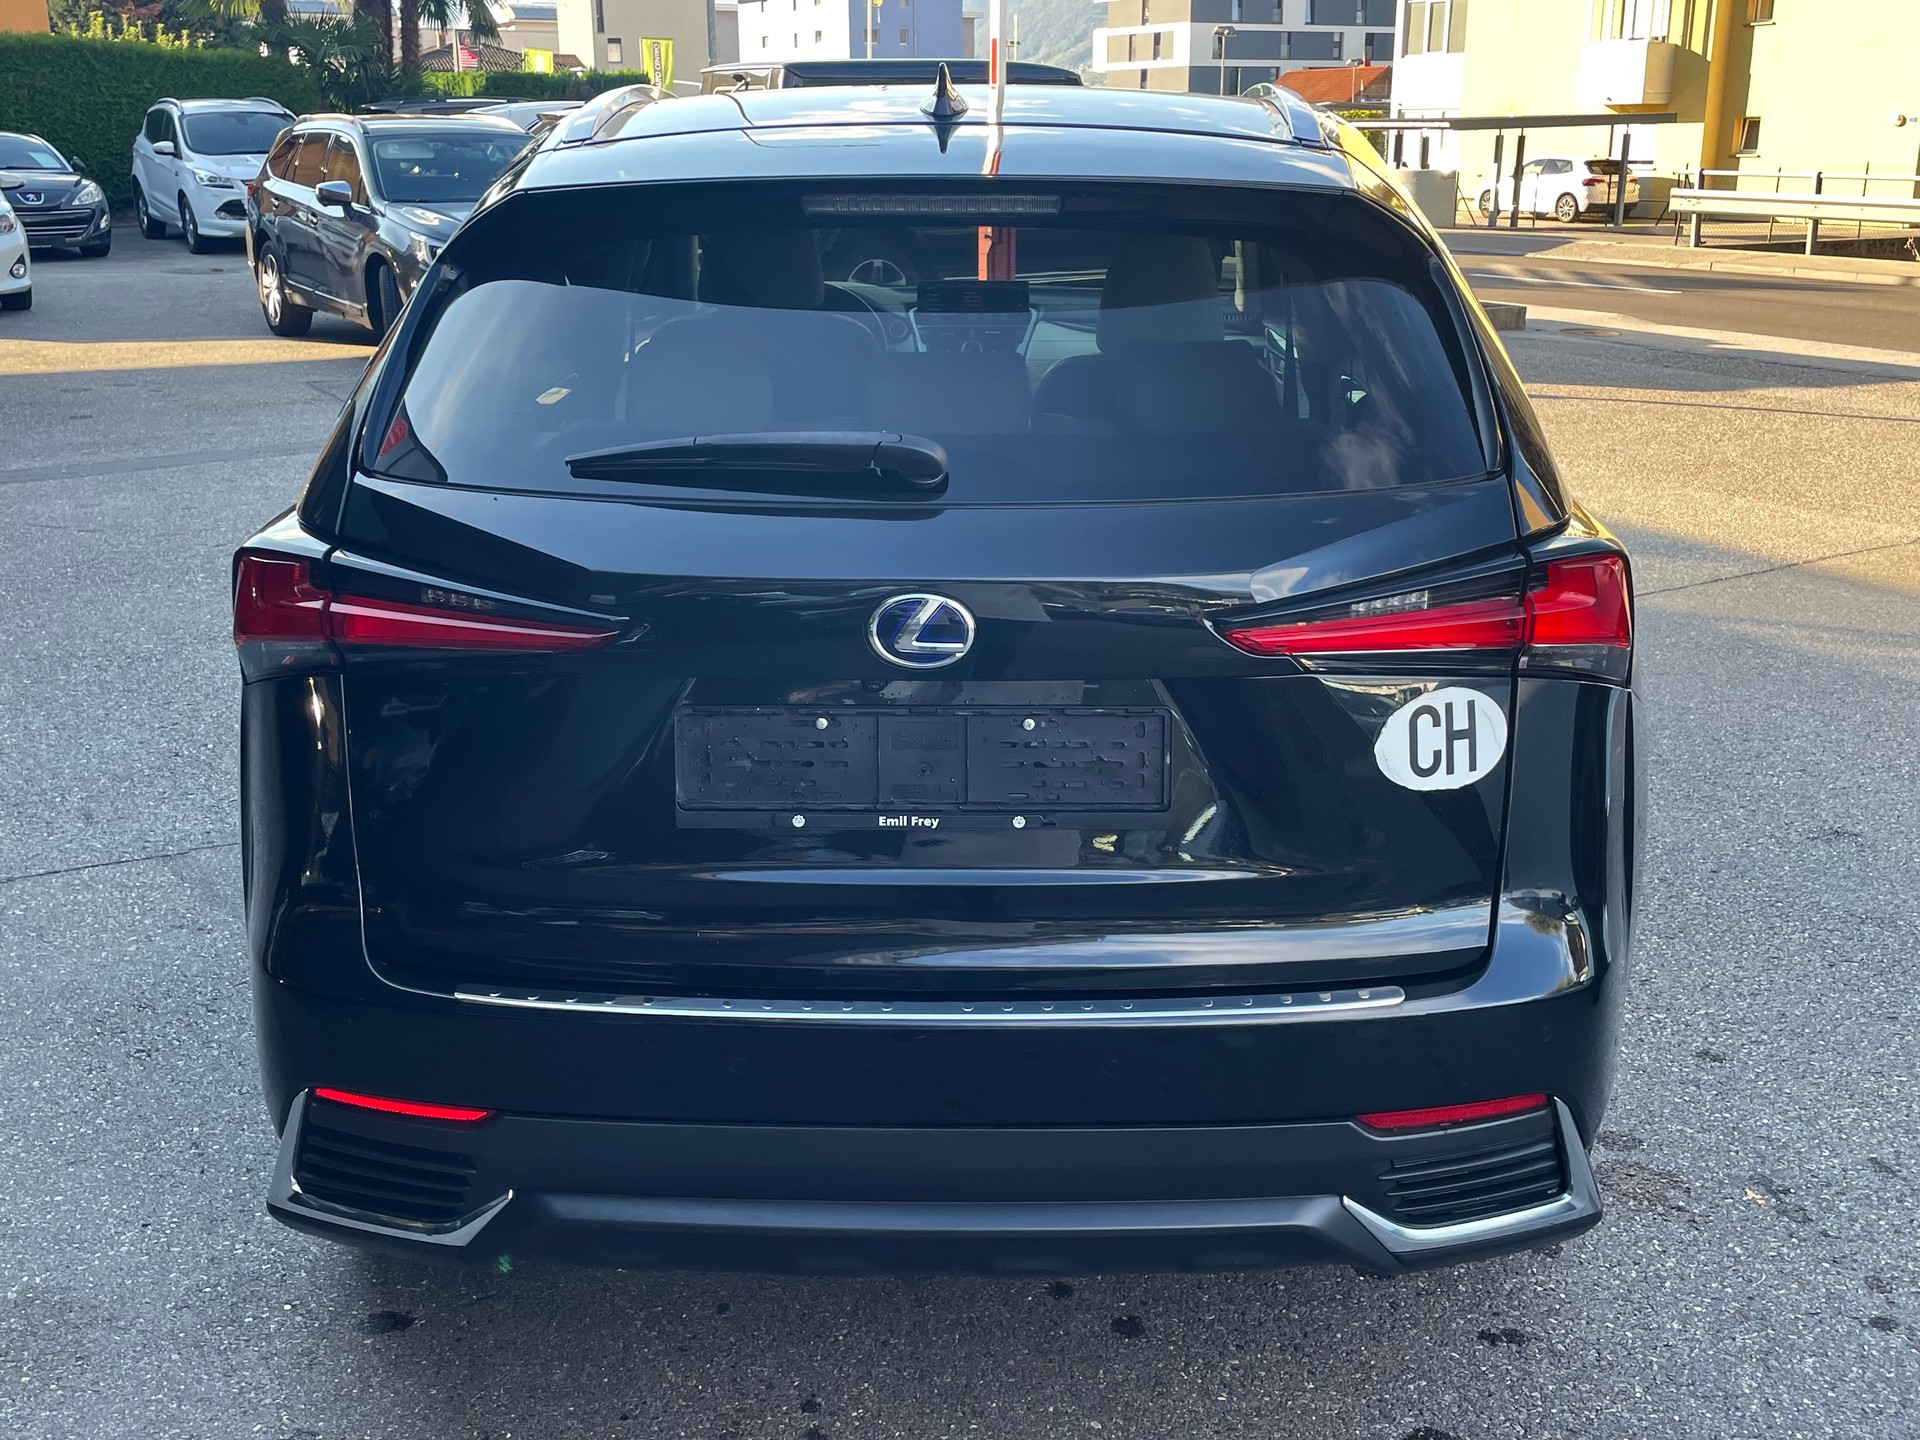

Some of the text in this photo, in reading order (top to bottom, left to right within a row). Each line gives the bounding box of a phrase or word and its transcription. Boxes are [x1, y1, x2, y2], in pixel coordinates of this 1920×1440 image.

[1408, 699, 1477, 778] CH
[878, 815, 940, 829] Emil Frey
